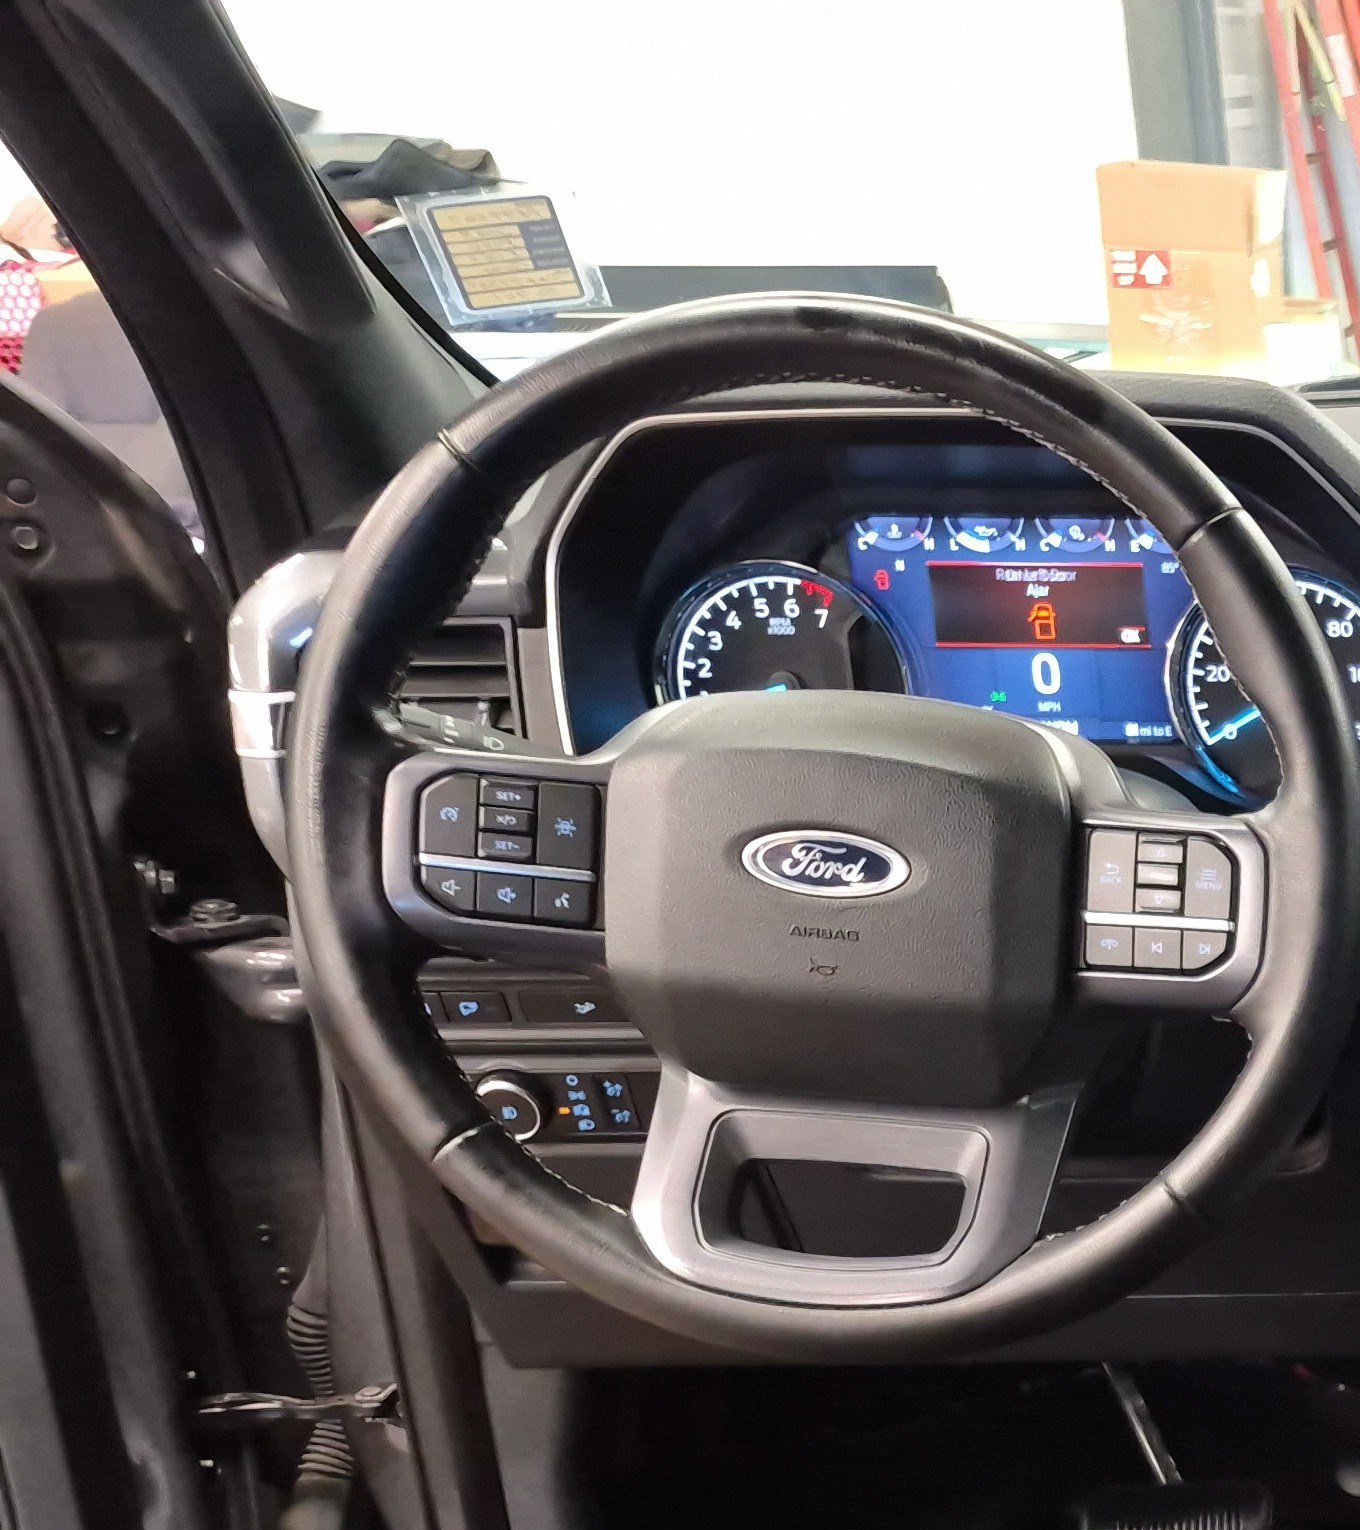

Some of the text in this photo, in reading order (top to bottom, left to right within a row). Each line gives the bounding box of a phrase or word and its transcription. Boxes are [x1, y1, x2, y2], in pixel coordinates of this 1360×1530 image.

[1026, 583, 1050, 598] Ajar
[754, 598, 769, 618] 5
[784, 598, 800, 618] 6
[815, 608, 828, 628] 7
[726, 611, 742, 630] 4
[1326, 620, 1354, 638] 80
[708, 631, 723, 651] 3
[697, 658, 713, 678] 2
[1031, 653, 1061, 695] 0
[1205, 665, 1230, 683] 20
[781, 842, 867, 883] Ford
